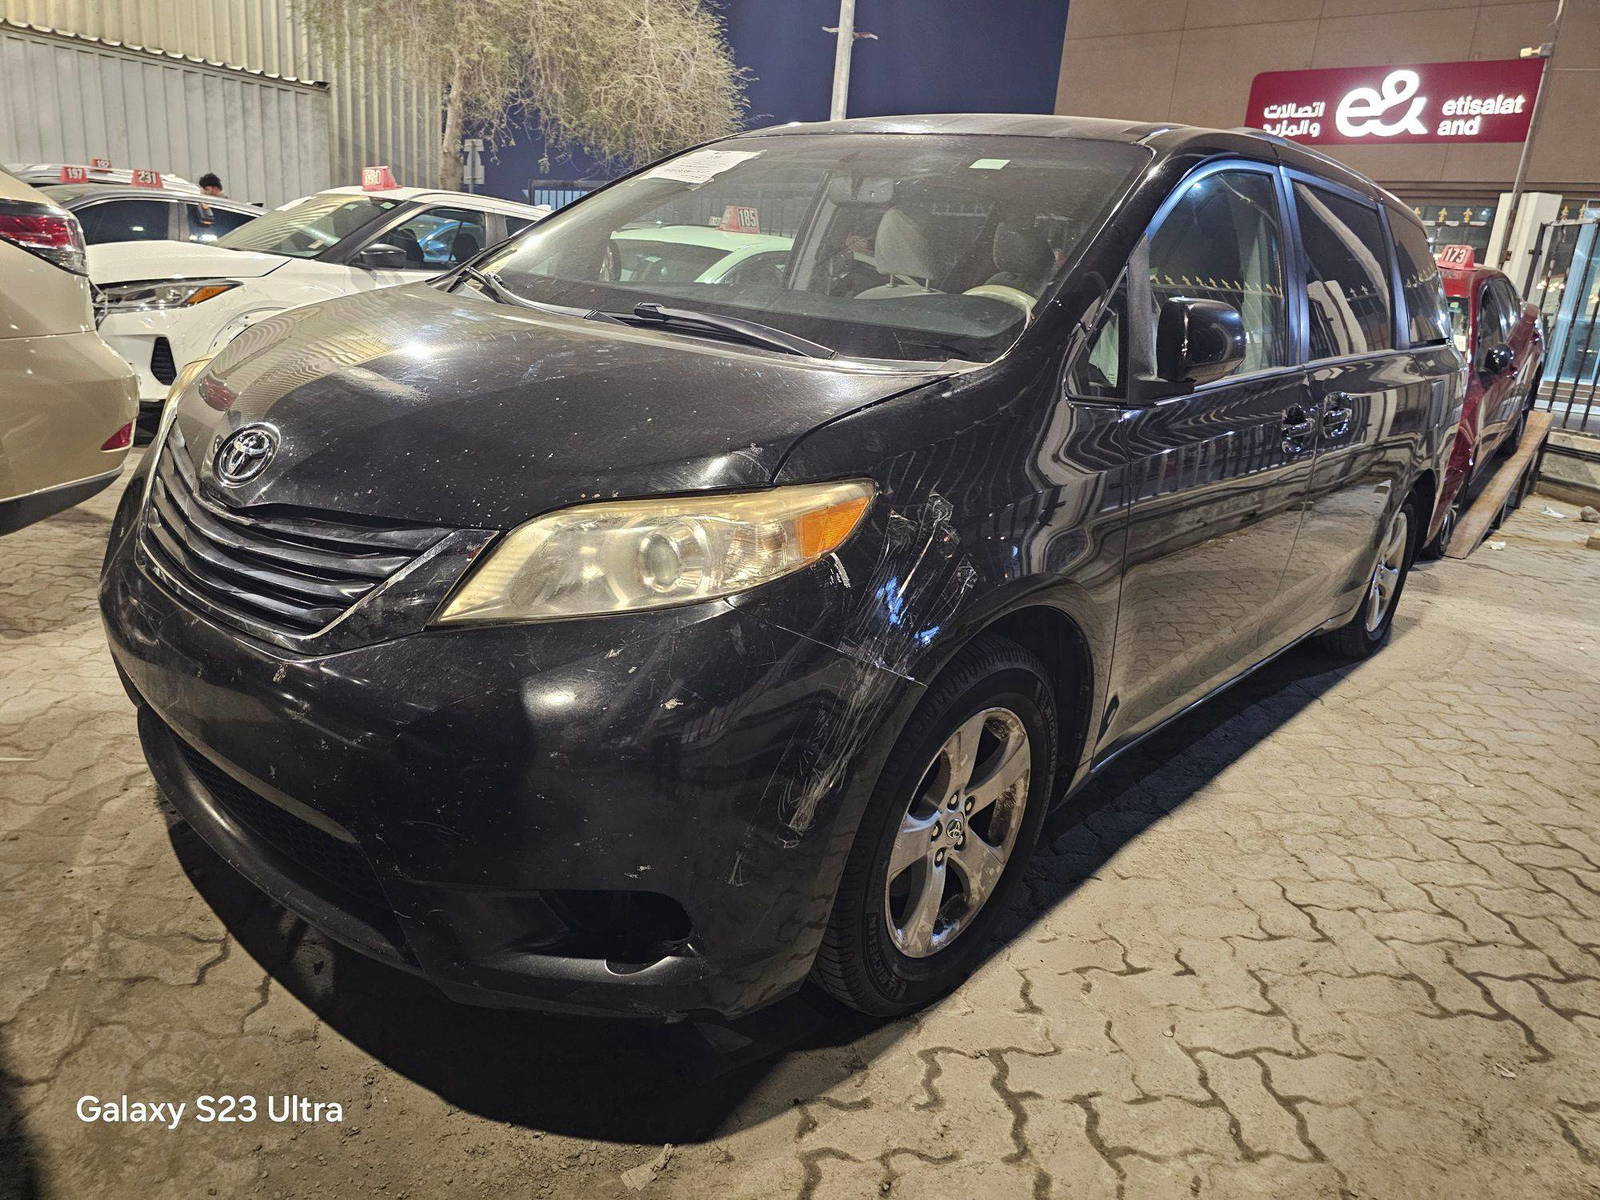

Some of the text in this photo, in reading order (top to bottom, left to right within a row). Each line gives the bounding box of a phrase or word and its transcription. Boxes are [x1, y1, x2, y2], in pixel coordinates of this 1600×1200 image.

[1263, 101, 1326, 119] اتصالات
[1441, 94, 1526, 117] etisalat
[1437, 116, 1482, 137] and
[138, 169, 157, 185] 231
[739, 209, 757, 227] 185
[1444, 247, 1467, 264] 173
